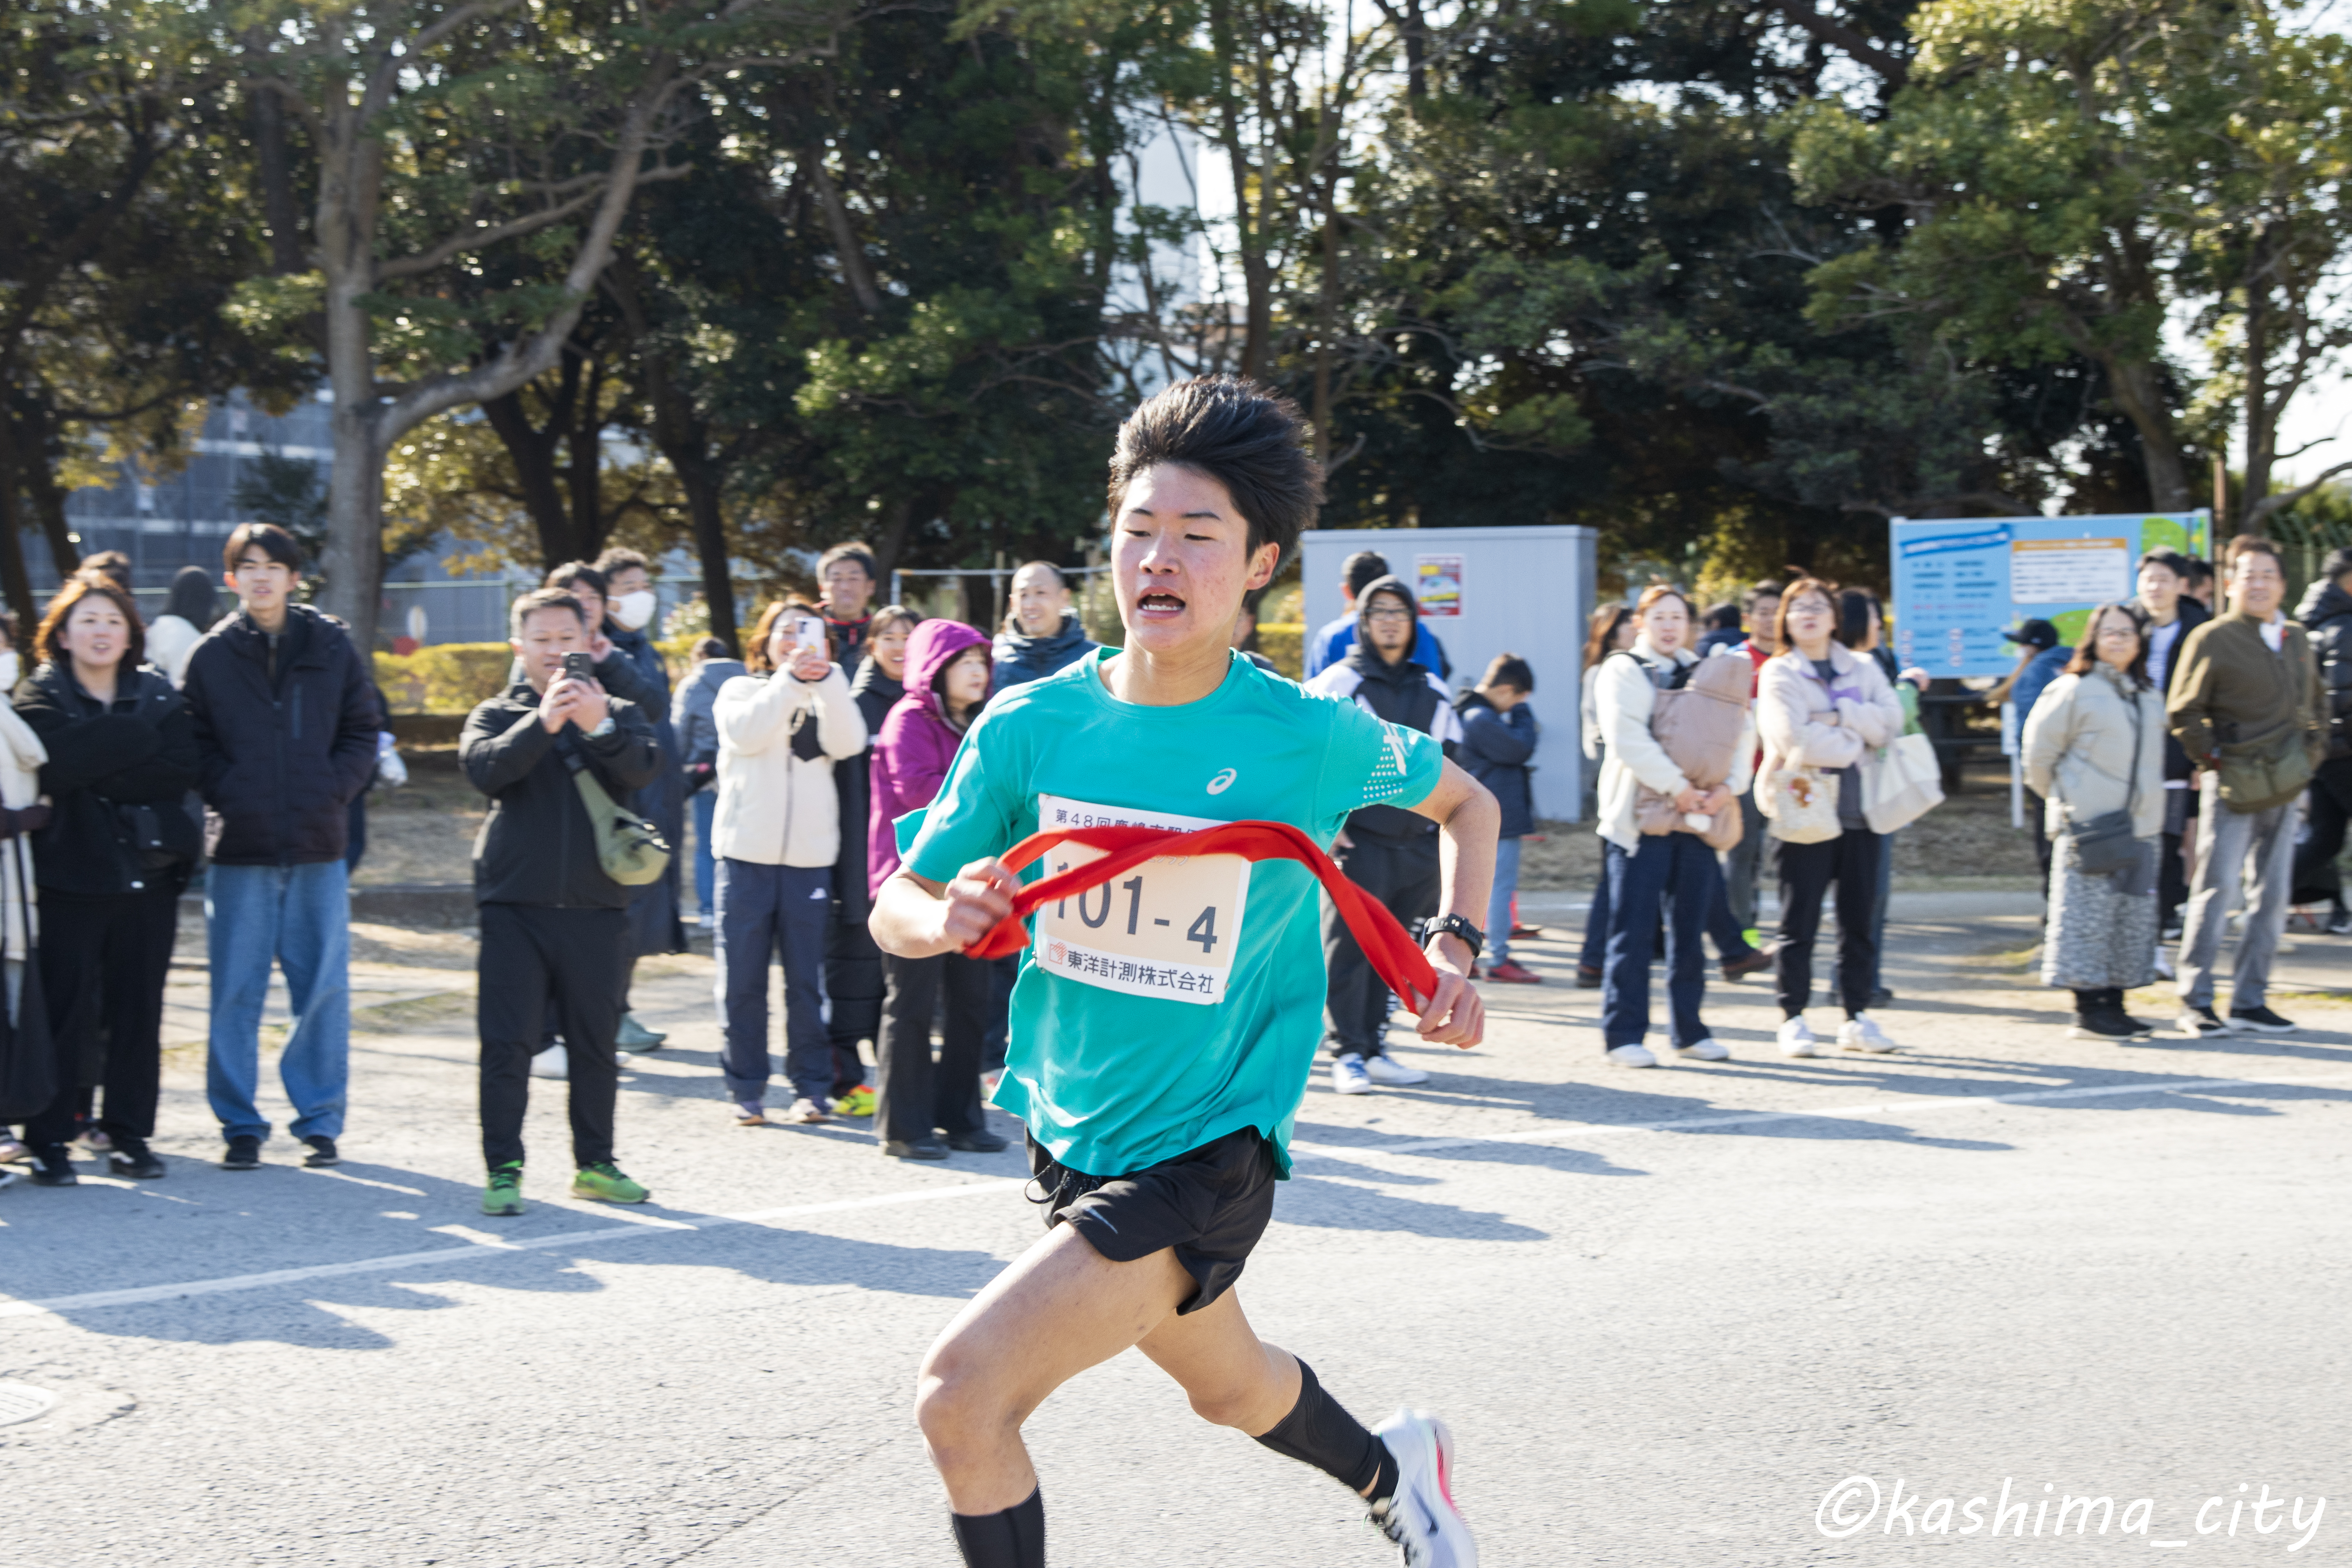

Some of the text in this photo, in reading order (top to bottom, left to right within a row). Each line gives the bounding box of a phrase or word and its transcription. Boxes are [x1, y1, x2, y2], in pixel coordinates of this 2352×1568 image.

[1068, 950, 1214, 994] 東洋計測株式会社
